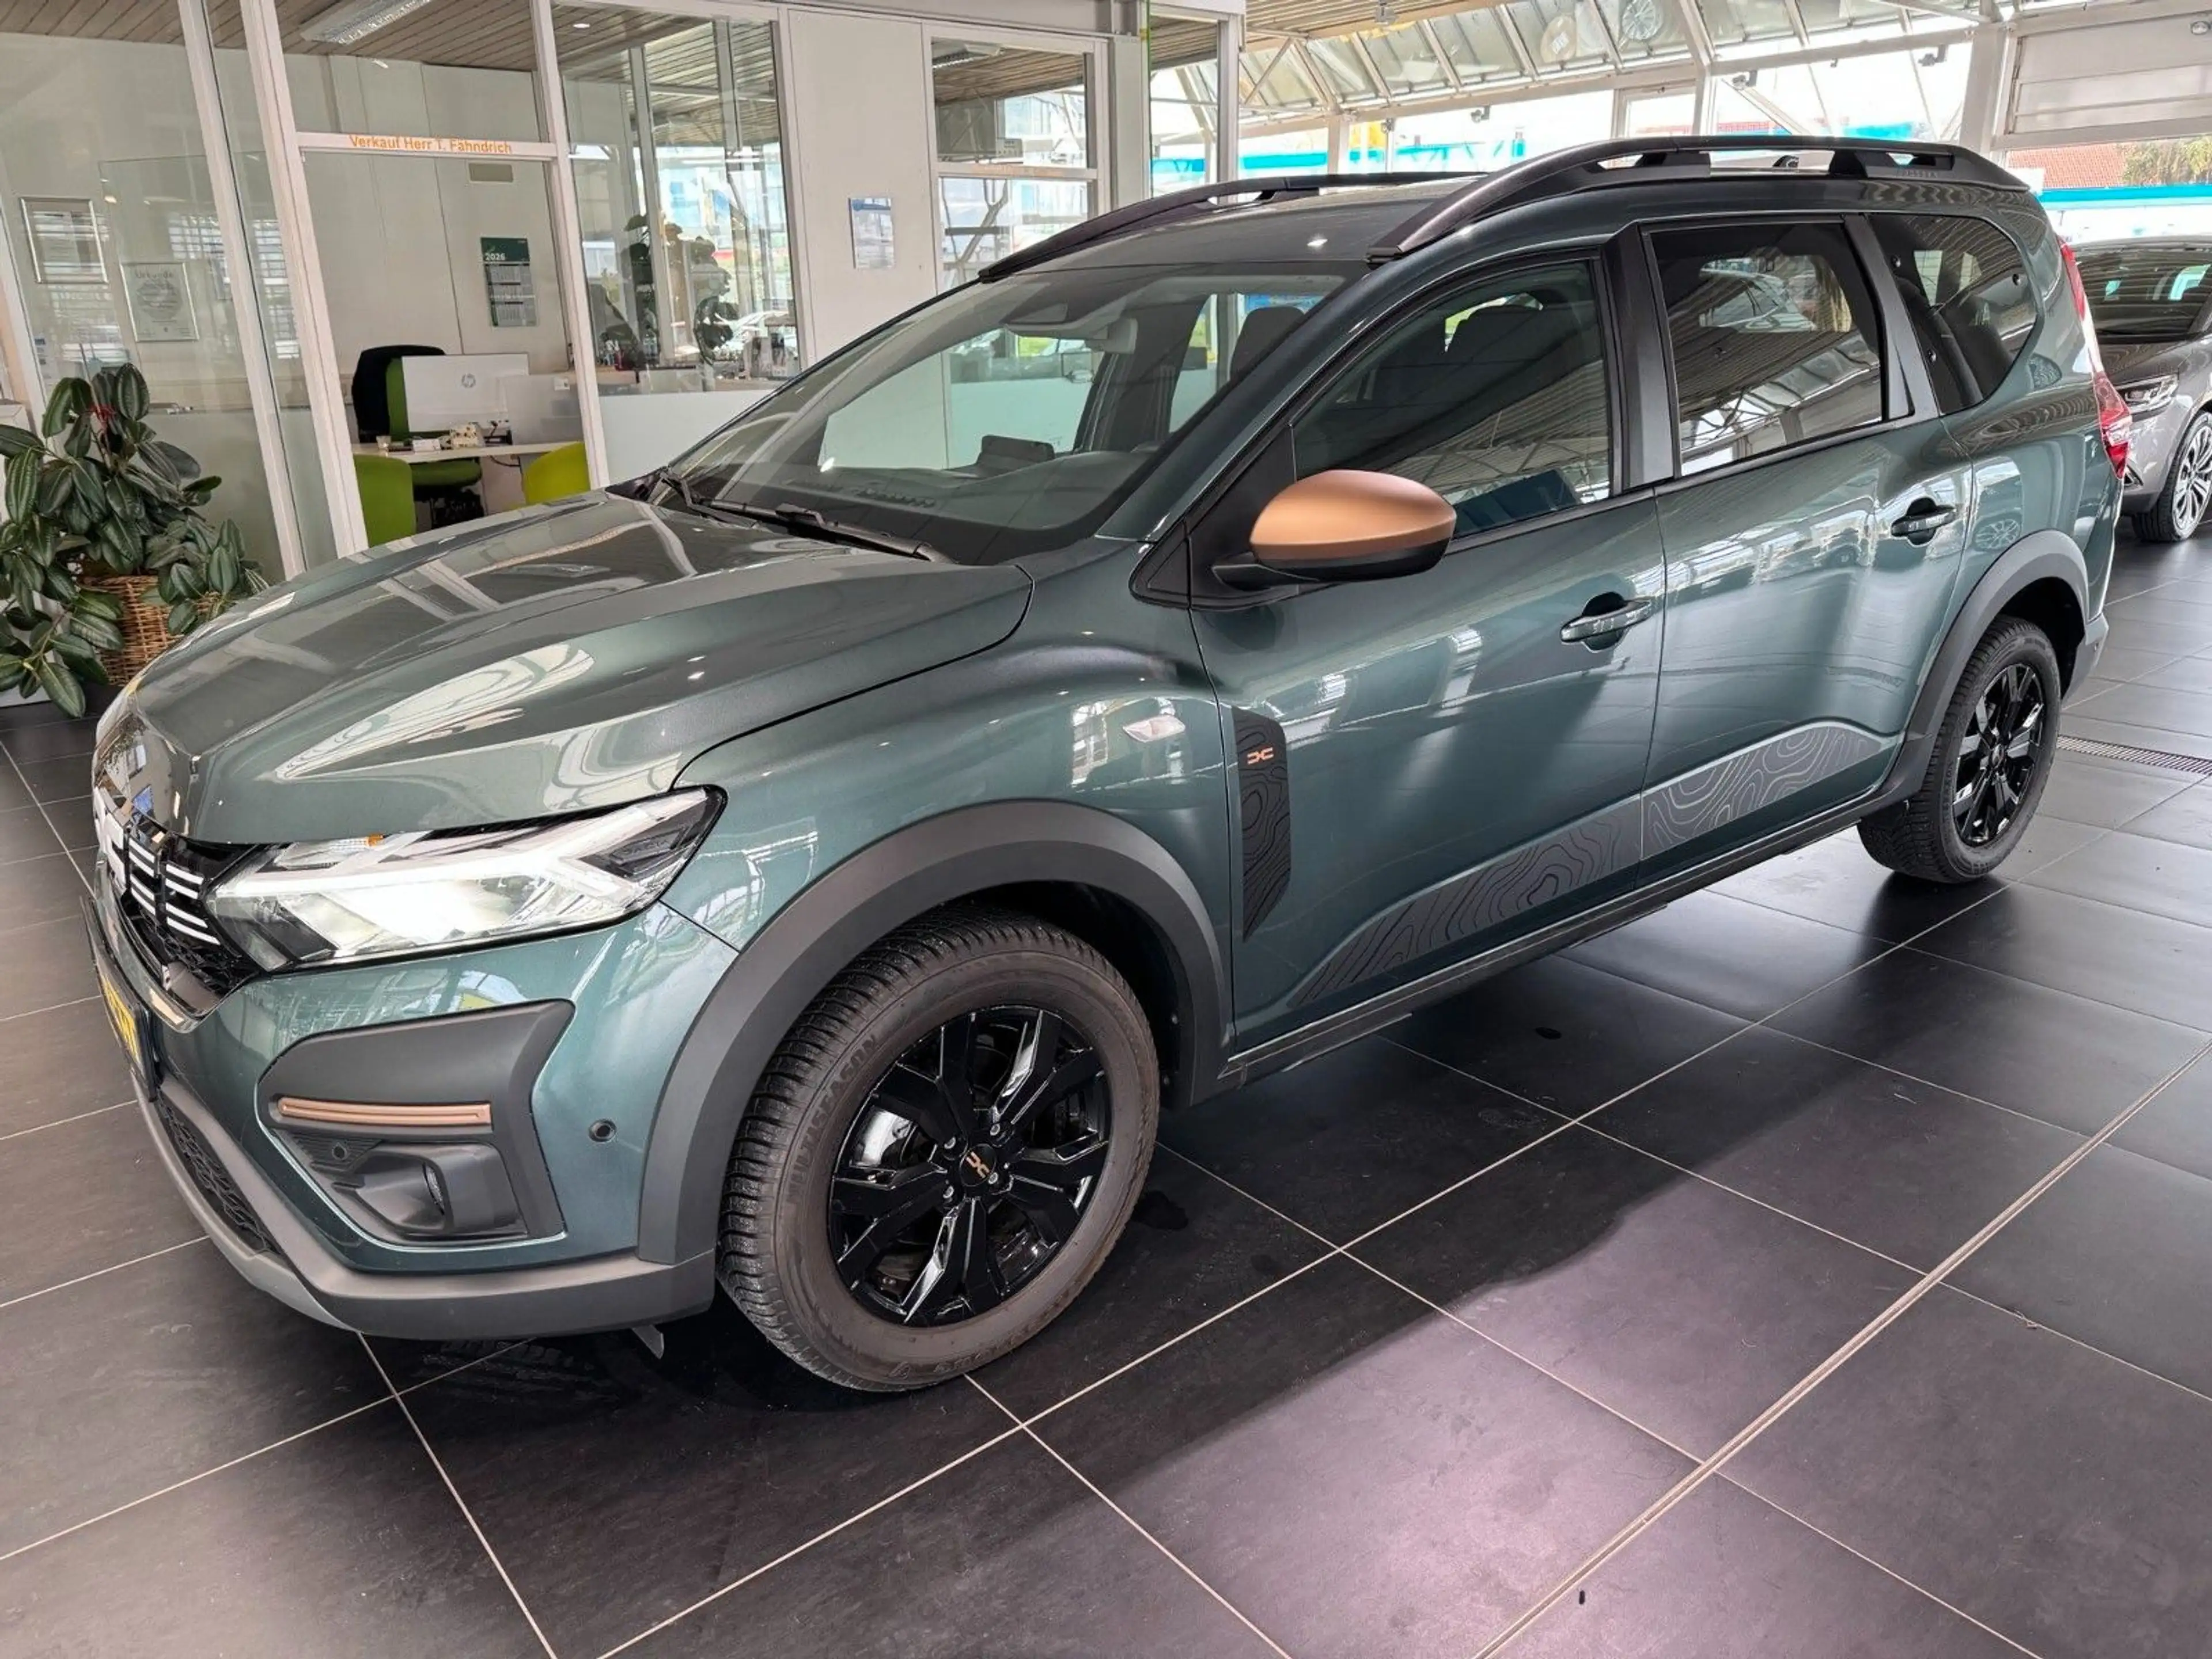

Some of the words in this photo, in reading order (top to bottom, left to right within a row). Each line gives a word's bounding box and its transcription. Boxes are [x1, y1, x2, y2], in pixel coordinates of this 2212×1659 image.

[350, 135, 400, 148] Verkauf
[404, 138, 432, 150] Herr
[434, 139, 446, 150] T.
[484, 252, 506, 260] 2026
